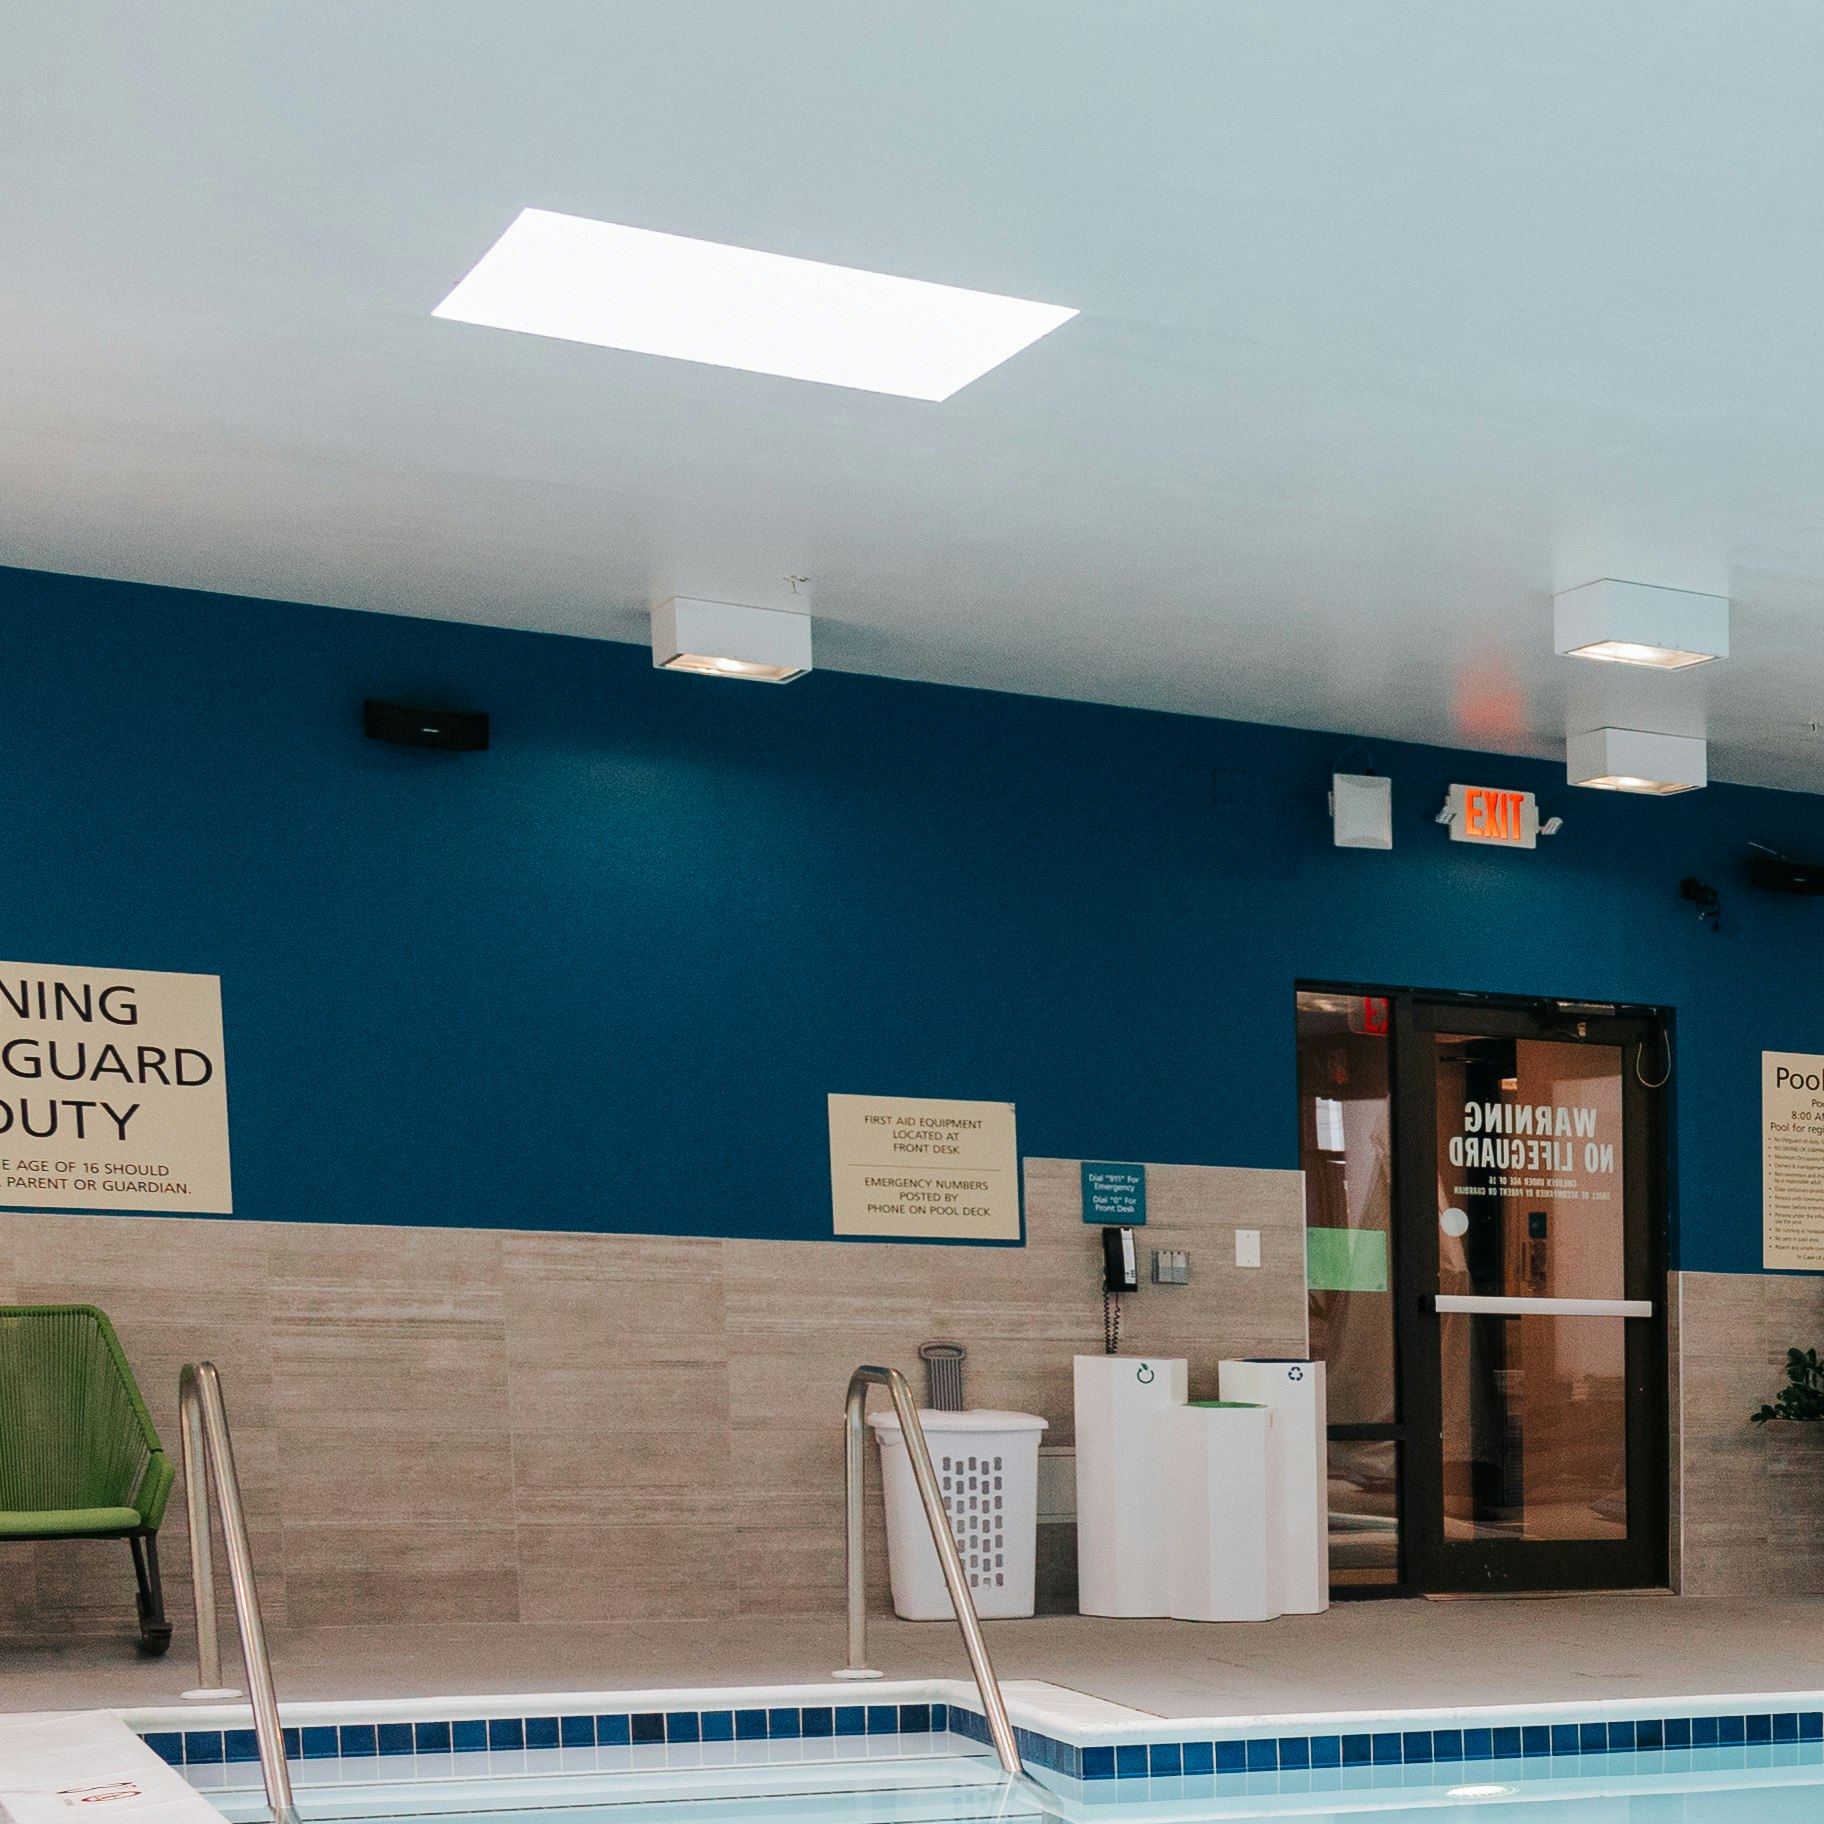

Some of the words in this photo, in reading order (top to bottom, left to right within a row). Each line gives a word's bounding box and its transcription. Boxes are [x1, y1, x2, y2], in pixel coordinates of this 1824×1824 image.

[1465, 787, 1524, 841] EXIT
[2, 1038, 213, 1086] GUARD
[864, 1115, 892, 1125] FIRST
[896, 1116, 915, 1126] AID
[920, 1117, 982, 1129] EQUIPMENT
[1791, 1111, 1812, 1121] 8:00
[1770, 1122, 1789, 1132] Pool
[1792, 1123, 1805, 1133] for
[893, 1130, 942, 1141] LOCATED
[946, 1132, 959, 1141] AT
[893, 1143, 928, 1153] FRONT
[933, 1144, 960, 1154] DESK
[16, 1160, 49, 1172] AGE
[55, 1161, 76, 1173] OF
[83, 1162, 99, 1174] 16
[104, 1163, 169, 1176] SHOULD
[7, 1176, 68, 1190] PARENT
[74, 1179, 97, 1191] OR
[102, 1180, 192, 1194] GUARDIAN.
[864, 1177, 932, 1189] EMERGENCY
[936, 1180, 988, 1190] NUMBERS
[900, 1191, 941, 1201] POSTED
[945, 1193, 958, 1202] BY
[867, 1204, 905, 1214] PHONE
[909, 1205, 926, 1215] ON
[930, 1206, 959, 1216] POOL
[963, 1207, 990, 1216] DECK
